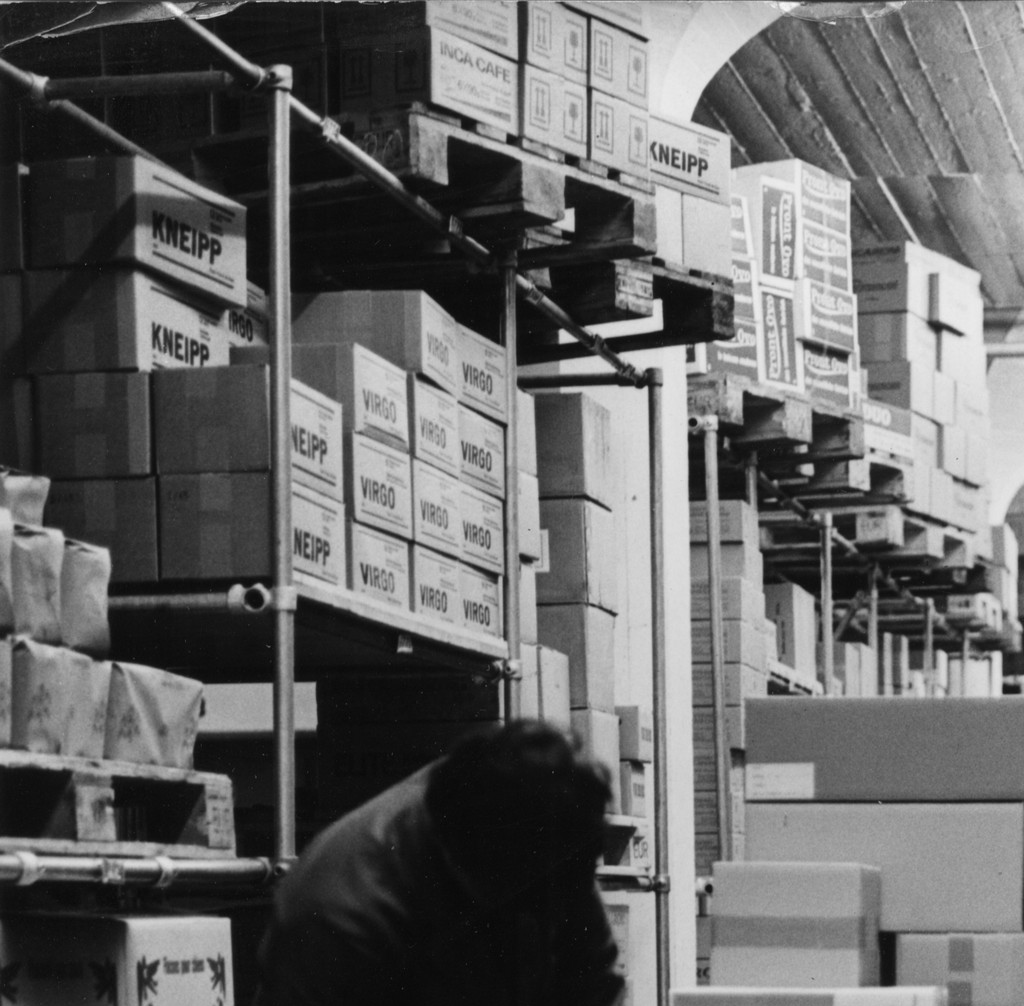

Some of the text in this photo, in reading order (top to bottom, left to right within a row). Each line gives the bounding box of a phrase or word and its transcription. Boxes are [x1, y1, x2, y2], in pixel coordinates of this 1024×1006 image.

[440, 41, 474, 68] INCA
[152, 210, 222, 265] KNEIPP
[152, 322, 210, 366] KNEIPP
[427, 331, 449, 367] VIRGO
[462, 362, 493, 395] VIRGO
[363, 388, 397, 423] VIRGO
[420, 416, 447, 449] VIRGO
[461, 440, 493, 472] VIRGO
[361, 475, 395, 509] VIRGO
[420, 499, 448, 530] VIRGO
[463, 520, 491, 550] VIRGO
[360, 562, 395, 594] VIRGO
[420, 583, 448, 613] VIRGO
[463, 599, 490, 627] VIRGO
